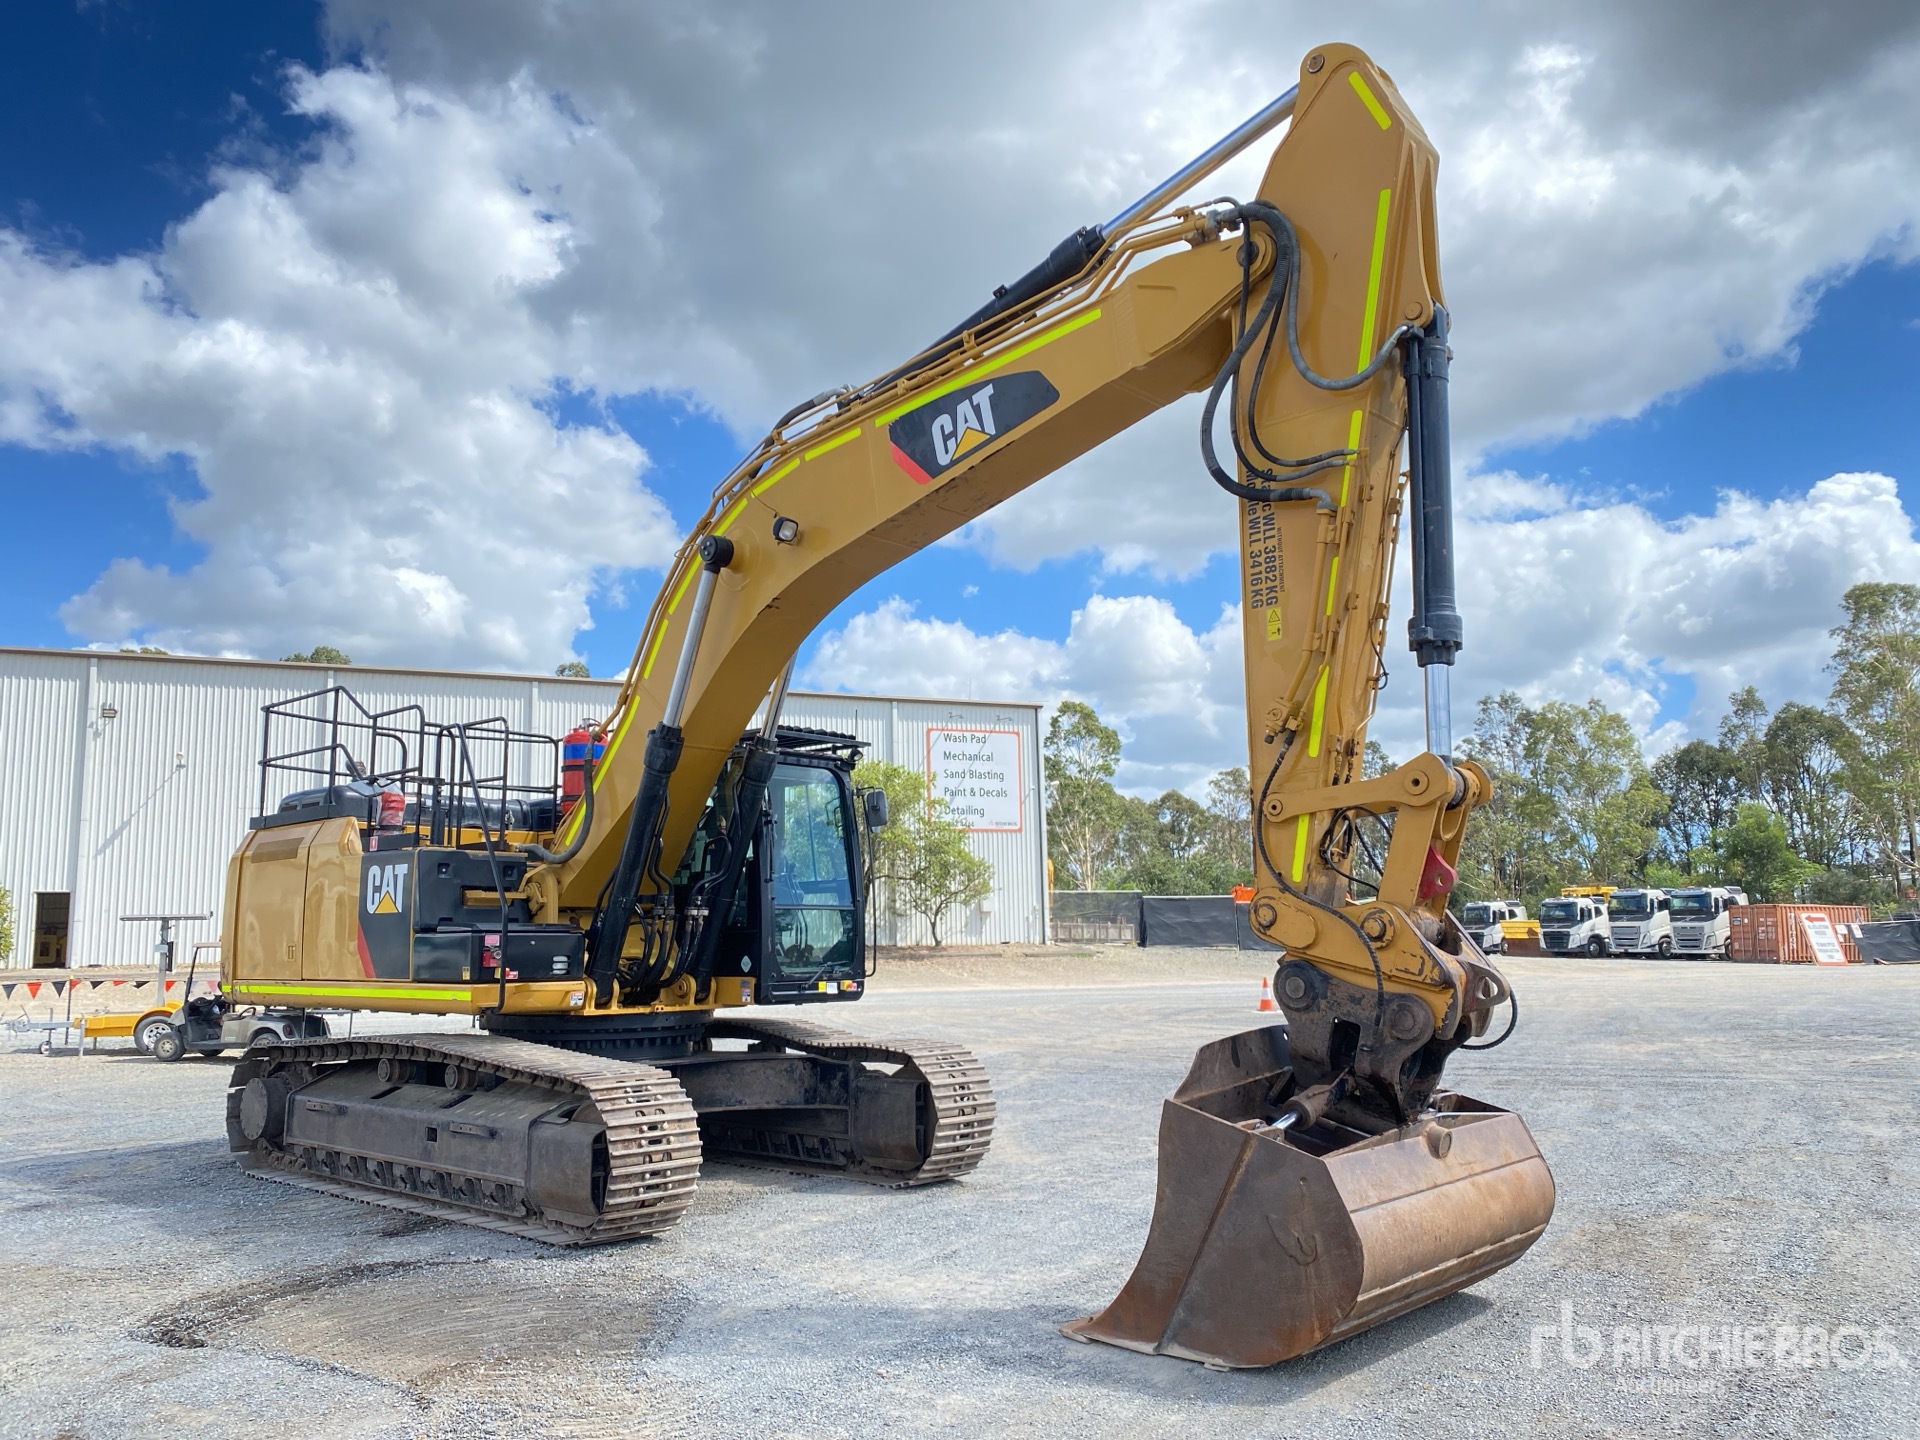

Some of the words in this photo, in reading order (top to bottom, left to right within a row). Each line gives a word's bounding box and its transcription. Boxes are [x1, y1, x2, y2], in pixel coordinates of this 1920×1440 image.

[931, 383, 996, 466] CAT
[1246, 469, 1259, 516] Mole
[1261, 468, 1273, 512] Stac
[1248, 516, 1262, 548] WLL
[1262, 512, 1275, 544] WLL
[1249, 550, 1263, 587] 3416
[1264, 545, 1277, 585] 3882
[1251, 589, 1264, 610] KG
[1265, 586, 1279, 607] KG
[943, 733, 968, 743] Wash
[970, 734, 987, 744] Pad
[943, 751, 994, 762] Mechanical
[944, 769, 966, 779] Sand
[969, 770, 1005, 782] Blasting
[944, 787, 967, 797] Paint
[969, 787, 977, 797] &
[979, 788, 1008, 798] Decals
[944, 805, 985, 818] Detailing
[366, 864, 409, 914] CAT
